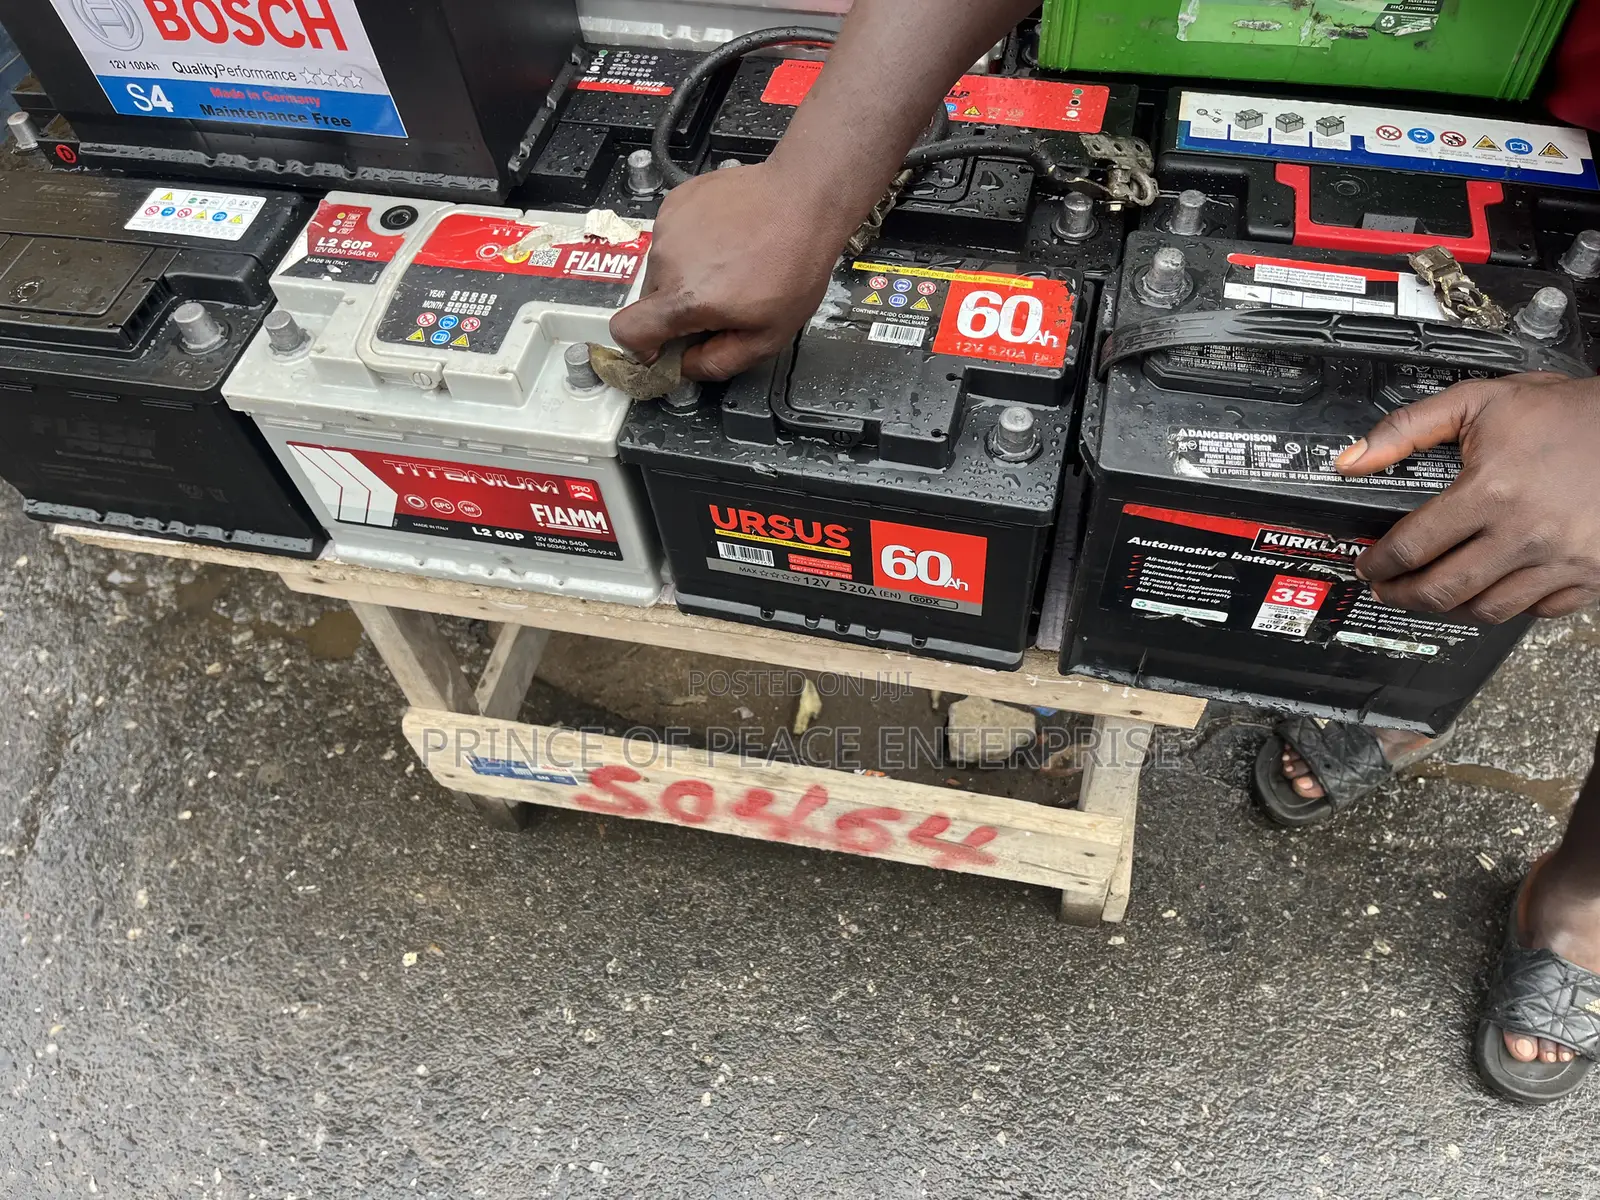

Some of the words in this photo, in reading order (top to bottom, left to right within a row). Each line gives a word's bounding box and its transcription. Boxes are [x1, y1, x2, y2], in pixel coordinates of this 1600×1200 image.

[143, 0, 349, 52] BOSCH
[109, 60, 126, 70] 12V
[128, 61, 160, 71] 100Ah
[172, 61, 297, 82] QualityPerformance
[126, 82, 174, 113] S4
[210, 87, 246, 100] Made
[249, 90, 260, 100] in
[262, 91, 320, 108] Germany
[200, 103, 308, 124] Maintenance
[312, 112, 352, 128] Free
[316, 236, 338, 247] L2
[340, 239, 372, 250] 60P
[566, 250, 639, 275] FIAMM
[429, 290, 446, 298] YEAR
[422, 300, 444, 310] MONTH
[852, 308, 879, 316] CONTIENE
[898, 313, 930, 321] CORROSIVO
[1188, 430, 1277, 442] DANGER/POISON
[1228, 468, 1249, 476] PORTÉE
[1369, 478, 1406, 487] COUVERCLES
[570, 484, 591, 493] PRO
[434, 501, 451, 510] SPC
[530, 503, 609, 531] FIAMM
[472, 526, 492, 537] L2
[496, 530, 525, 542] 60P
[708, 504, 851, 549] URSUS
[1263, 532, 1370, 557] KIRKLAN
[1127, 536, 1228, 558] Automotive
[1230, 551, 1296, 570] battery
[881, 544, 969, 592] 60Ah
[1143, 562, 1184, 574] Dependable
[1184, 570, 1212, 578] starting
[1146, 556, 1186, 567] All-weather
[1186, 563, 1212, 572] battery
[739, 566, 758, 576] MAX
[804, 576, 830, 588] 12V
[839, 582, 876, 596] 520A
[880, 590, 902, 600] (EN)
[1141, 569, 1200, 582] Maintenance-free
[1152, 578, 1172, 586] month
[913, 596, 940, 606] 60DX
[1175, 586, 1200, 594] limited
[1201, 590, 1232, 600] warranty
[1272, 588, 1317, 606] 35
[1372, 605, 1407, 614] entretien
[1342, 619, 1362, 627] N'est
[1350, 608, 1378, 617] Période
[1389, 614, 1442, 627] remplacement
[1442, 622, 1468, 631] gratuit
[1378, 618, 1408, 627] garantie
[1408, 622, 1434, 631] limitée
